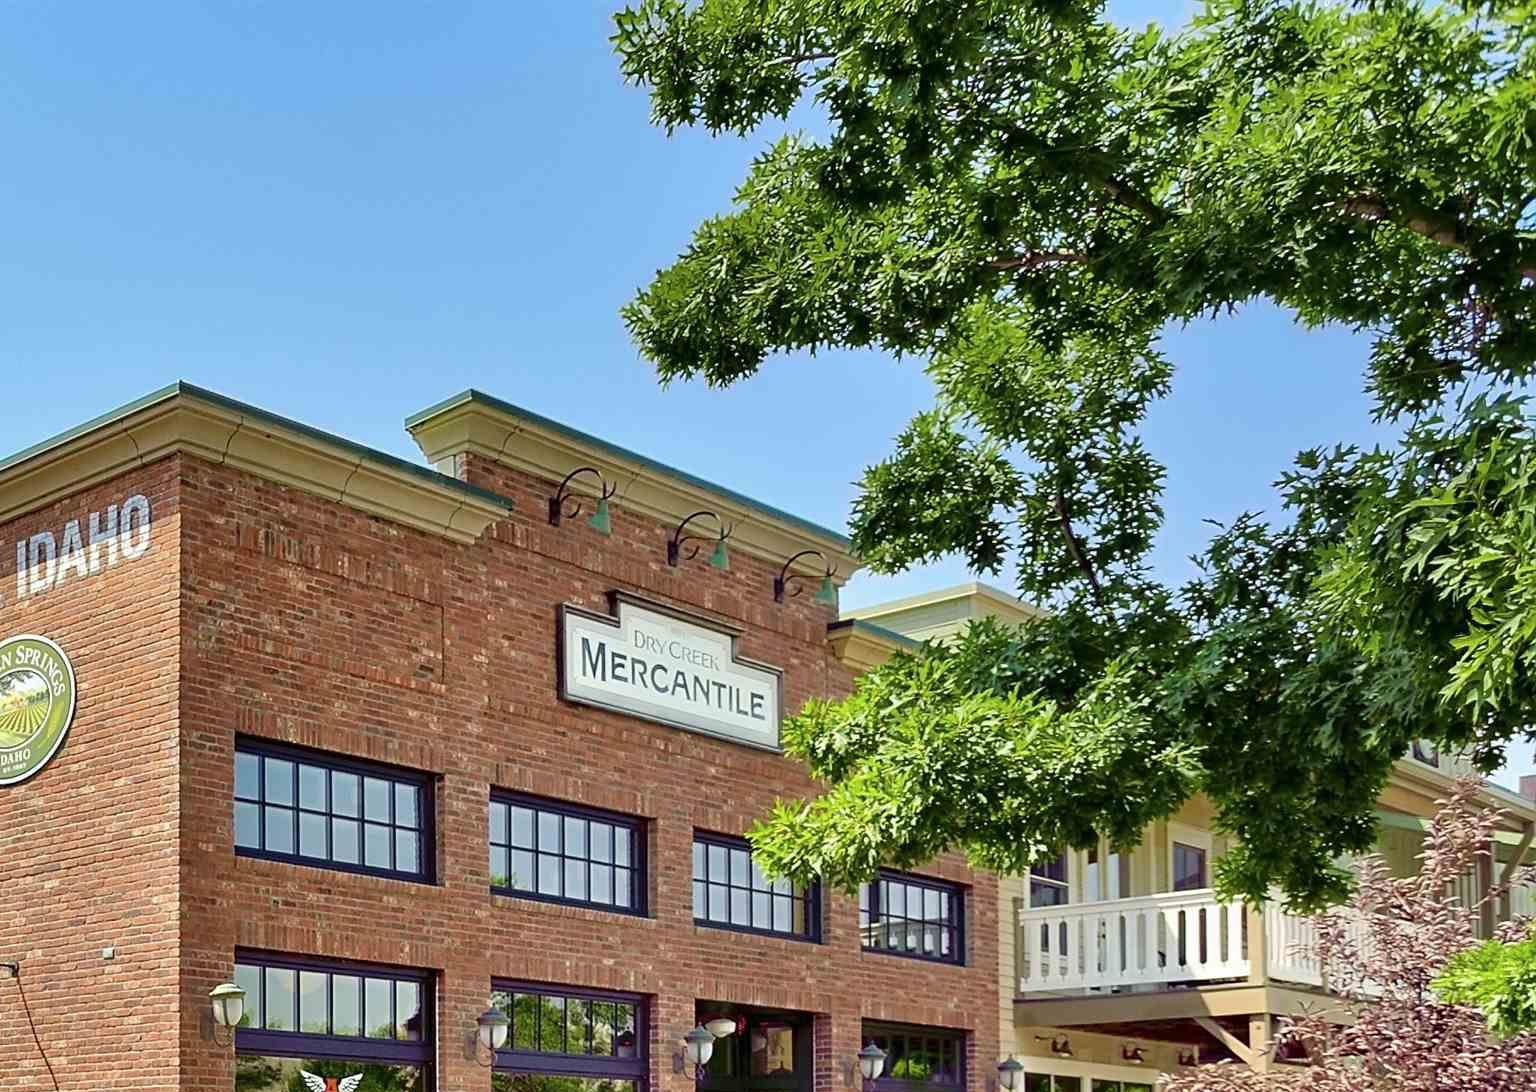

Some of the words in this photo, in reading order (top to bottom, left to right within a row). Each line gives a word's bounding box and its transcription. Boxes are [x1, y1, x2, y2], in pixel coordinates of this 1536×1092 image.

[15, 493, 153, 600] IDAHO
[15, 645, 66, 697] SPRINGS
[580, 636, 766, 721] MERCANTILE
[633, 629, 667, 655] DRY
[668, 641, 720, 672] CREEK
